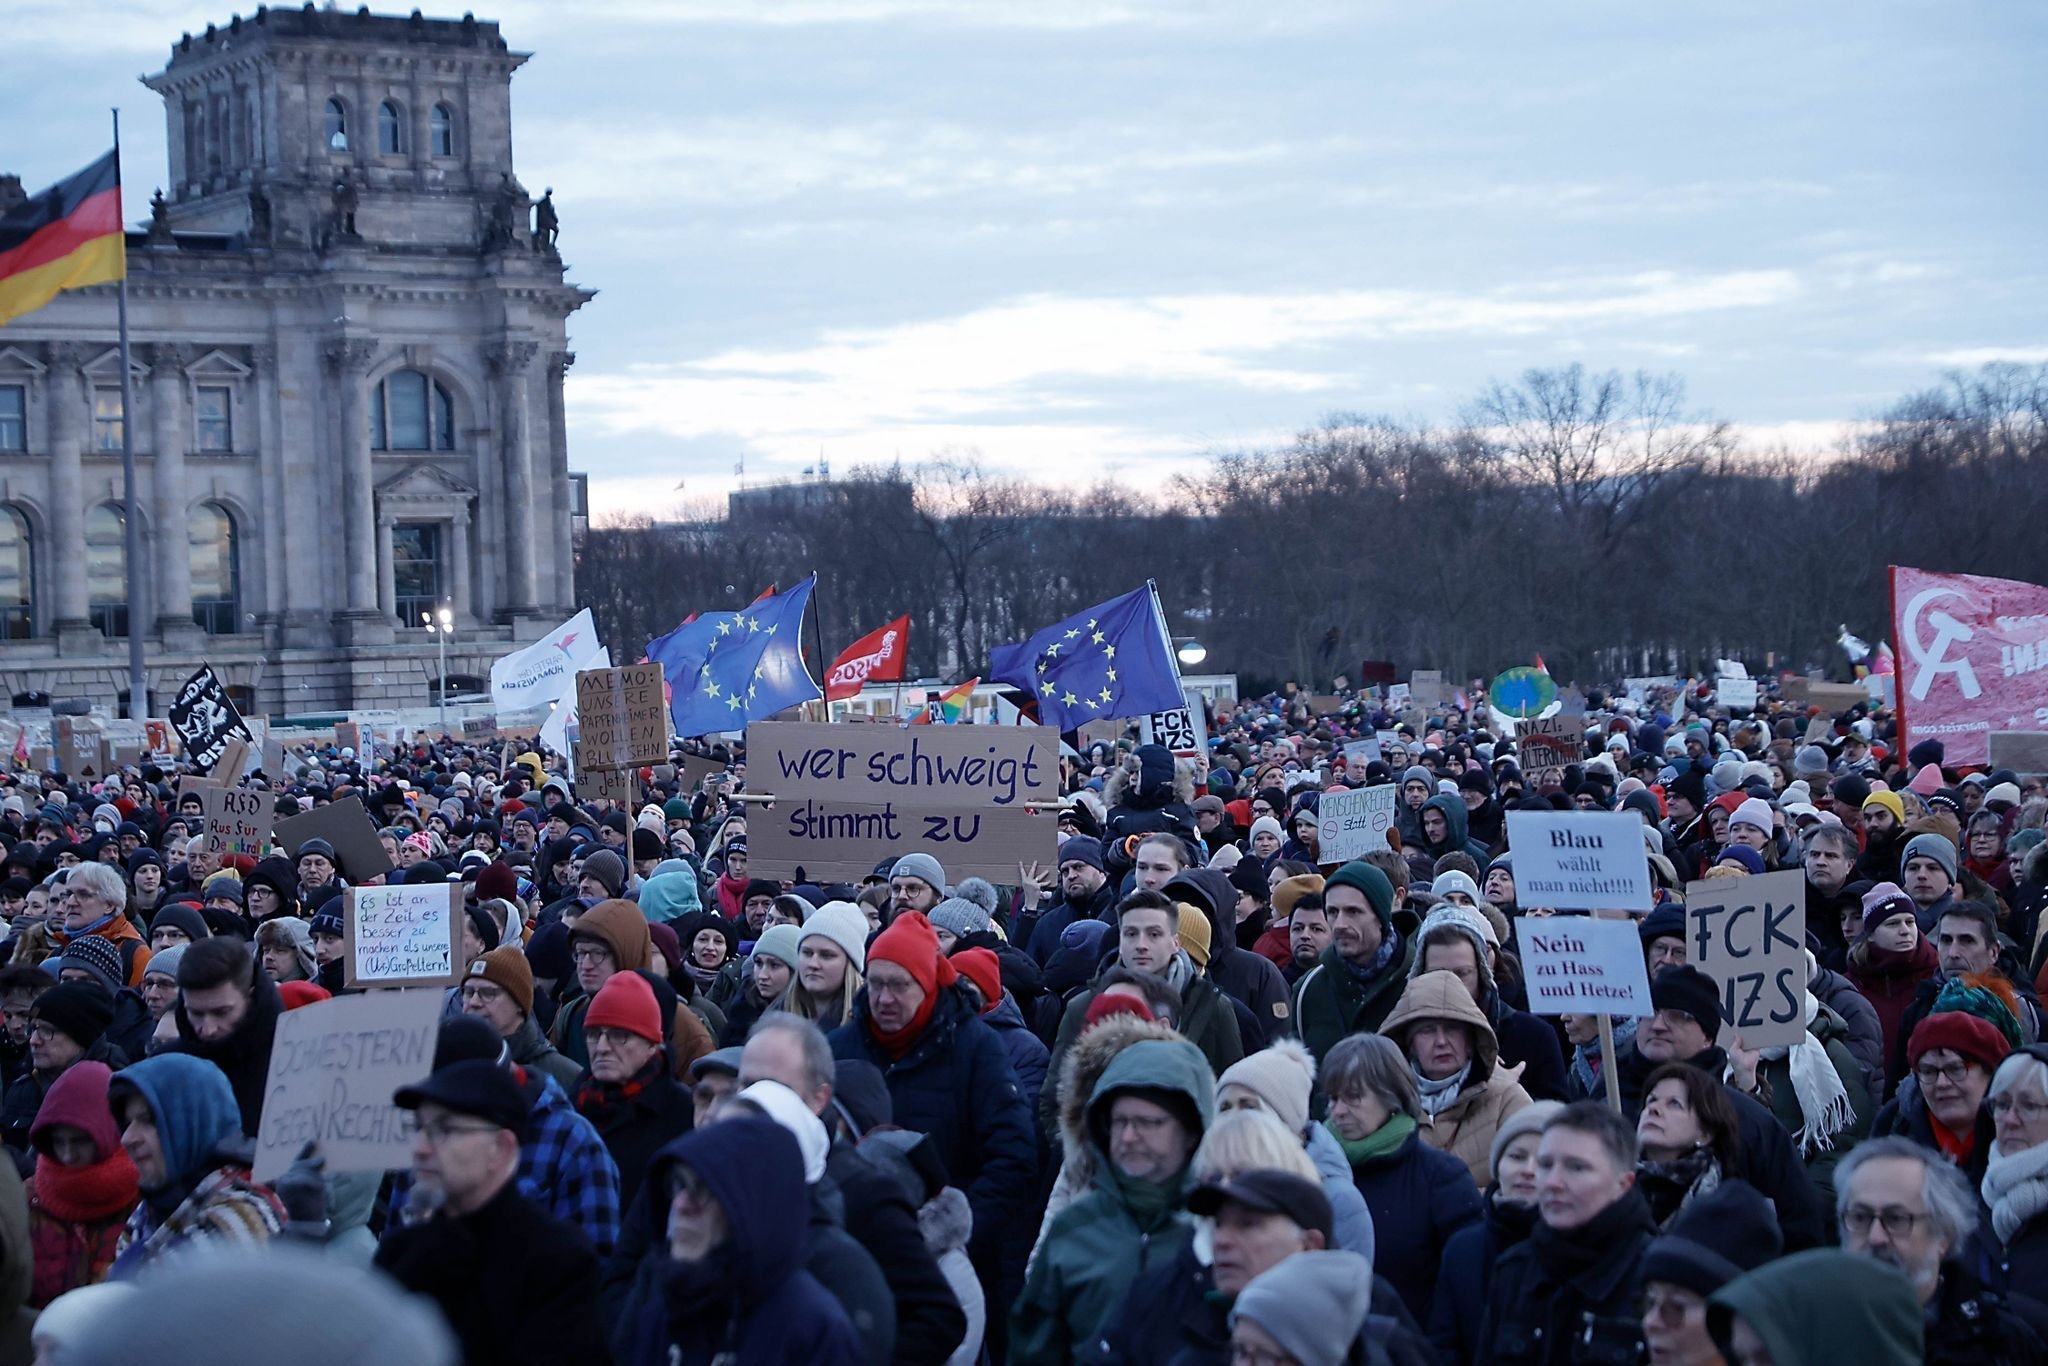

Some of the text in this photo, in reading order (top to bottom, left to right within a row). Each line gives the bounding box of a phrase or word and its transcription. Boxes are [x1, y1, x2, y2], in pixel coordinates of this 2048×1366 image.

[582, 689, 649, 712] UNSERE
[1151, 710, 1191, 732] FCK
[585, 726, 654, 745] WOLLEN
[1153, 729, 1196, 750] NZS
[778, 738, 1042, 804] wer schweigt
[1550, 830, 1603, 849] Blau
[1557, 856, 1601, 873] wählt
[1529, 877, 1634, 894] man nicht!!!!
[386, 891, 403, 906] ist
[411, 896, 428, 905] an
[360, 907, 438, 924] der Zeit es
[362, 925, 401, 940] besser
[1690, 902, 1799, 961] FCK
[358, 940, 398, 955] machen
[404, 938, 419, 953] als
[1531, 935, 1585, 953] Nein
[1536, 960, 1604, 977] zu Hass
[1540, 981, 1633, 1000] und Hetze!
[1720, 967, 1799, 1028] NZS
